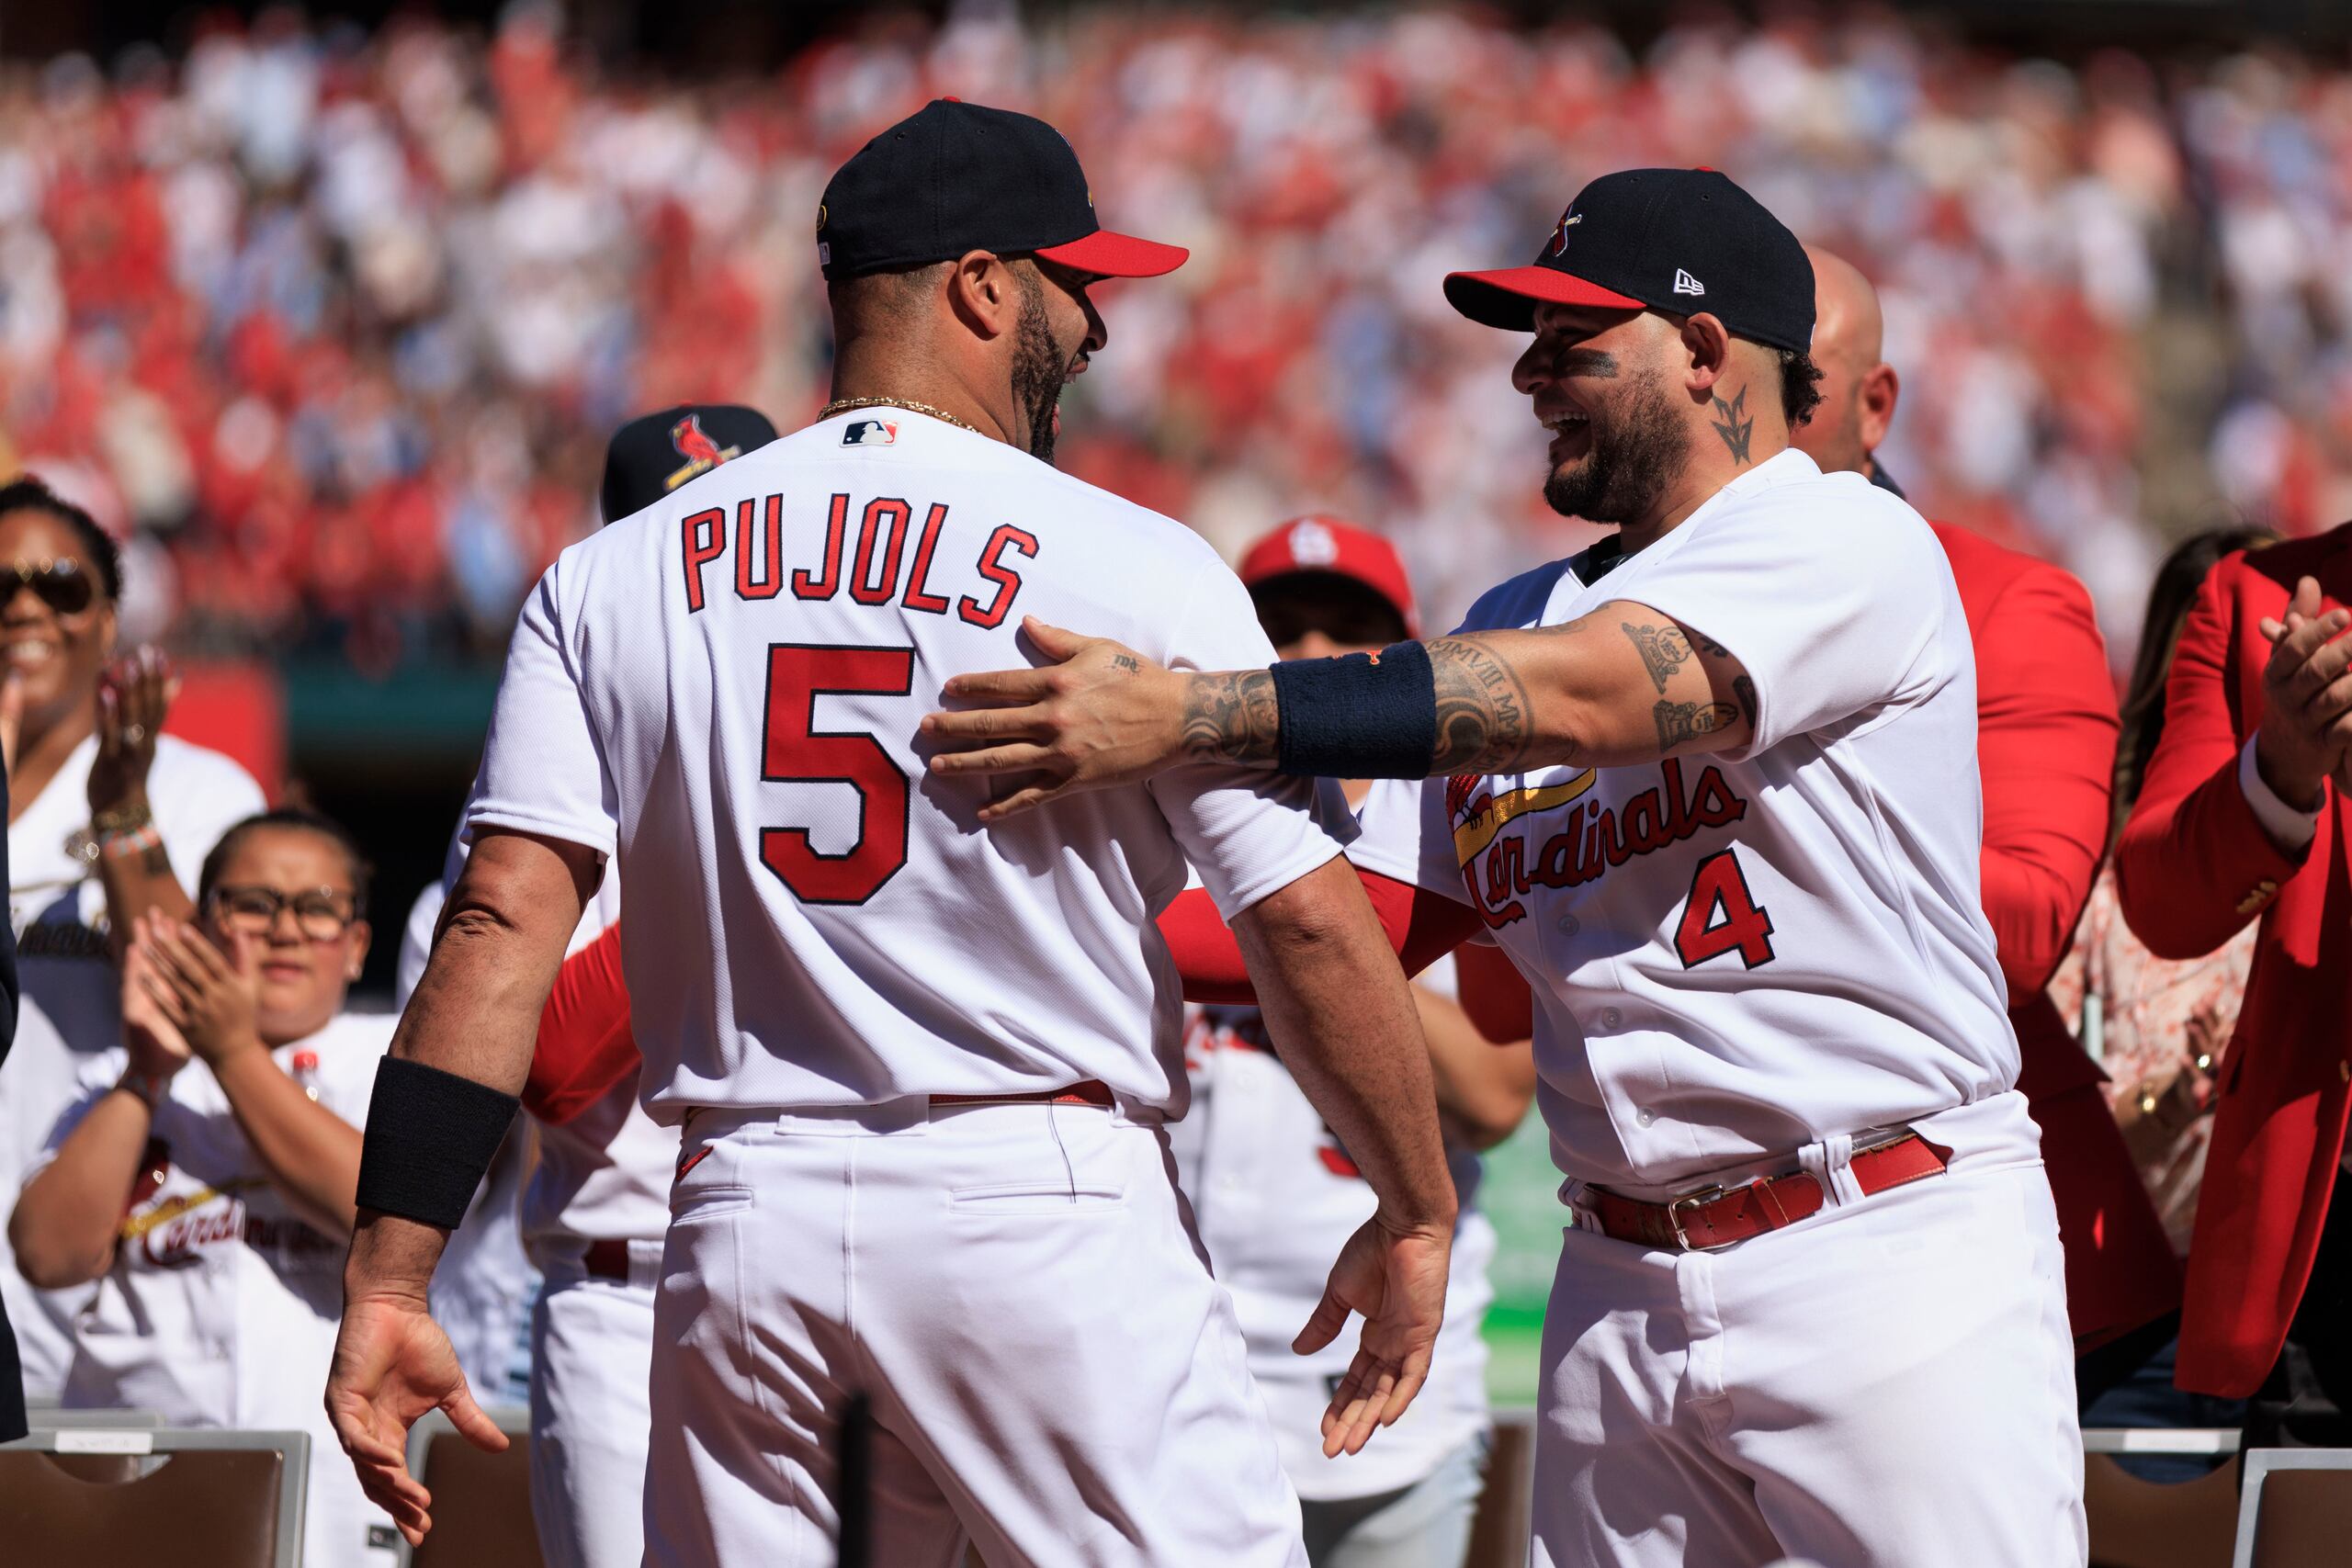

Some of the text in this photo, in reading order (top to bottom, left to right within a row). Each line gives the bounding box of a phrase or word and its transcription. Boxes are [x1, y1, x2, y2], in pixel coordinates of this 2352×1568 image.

[681, 493, 1040, 630] PUJOLS
[759, 643, 915, 906] 5
[1461, 757, 1747, 931] Cardinals
[1673, 847, 1775, 970] 4
